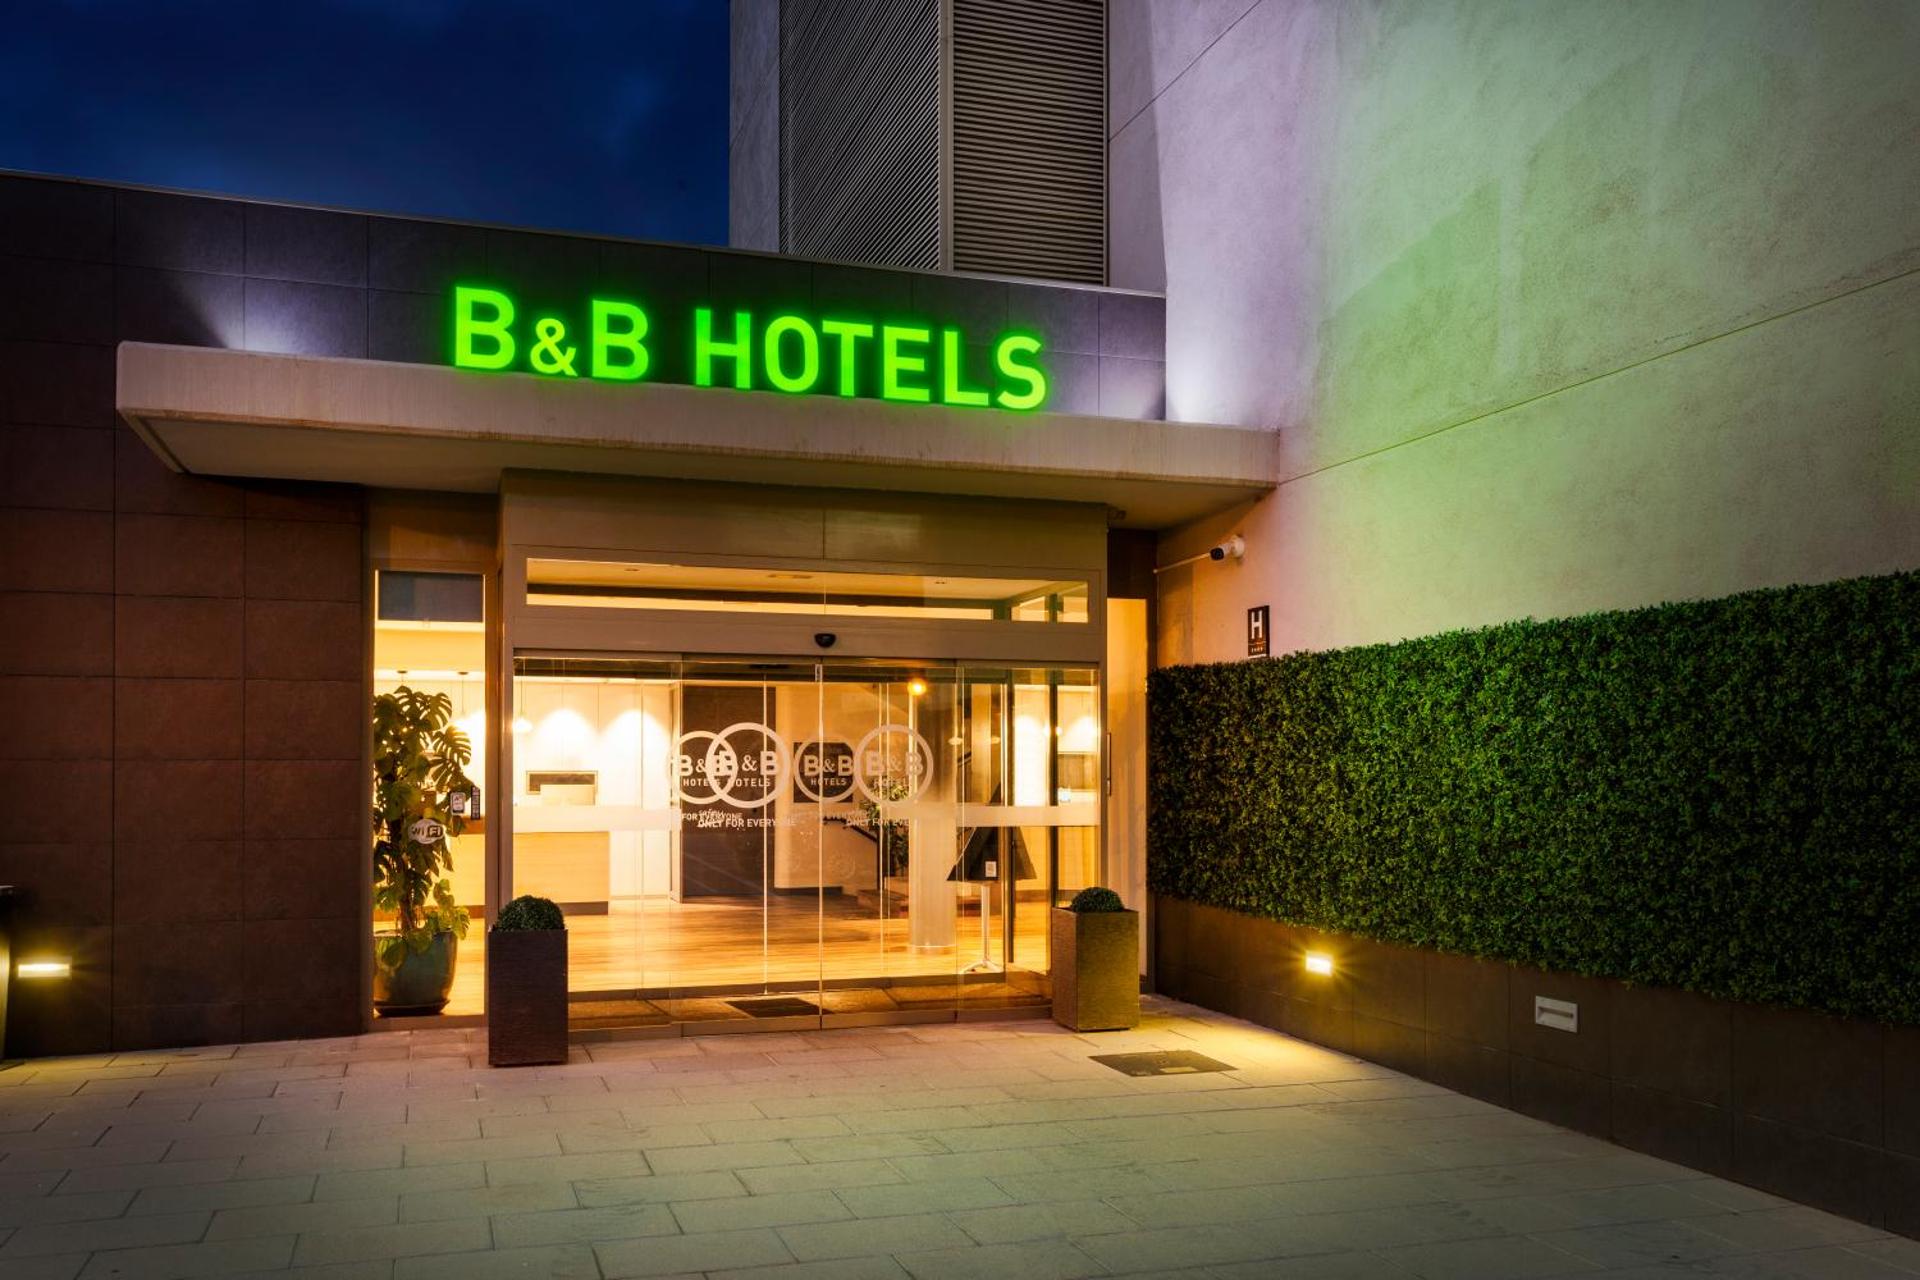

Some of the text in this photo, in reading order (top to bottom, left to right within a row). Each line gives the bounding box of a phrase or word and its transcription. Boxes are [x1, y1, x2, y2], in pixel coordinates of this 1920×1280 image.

[455, 286, 1046, 410] B&B HOTELS
[1251, 610, 1263, 639] H
[804, 754, 854, 777] B&B
[810, 777, 847, 787] HOTELS
[725, 817, 745, 828] FOR
